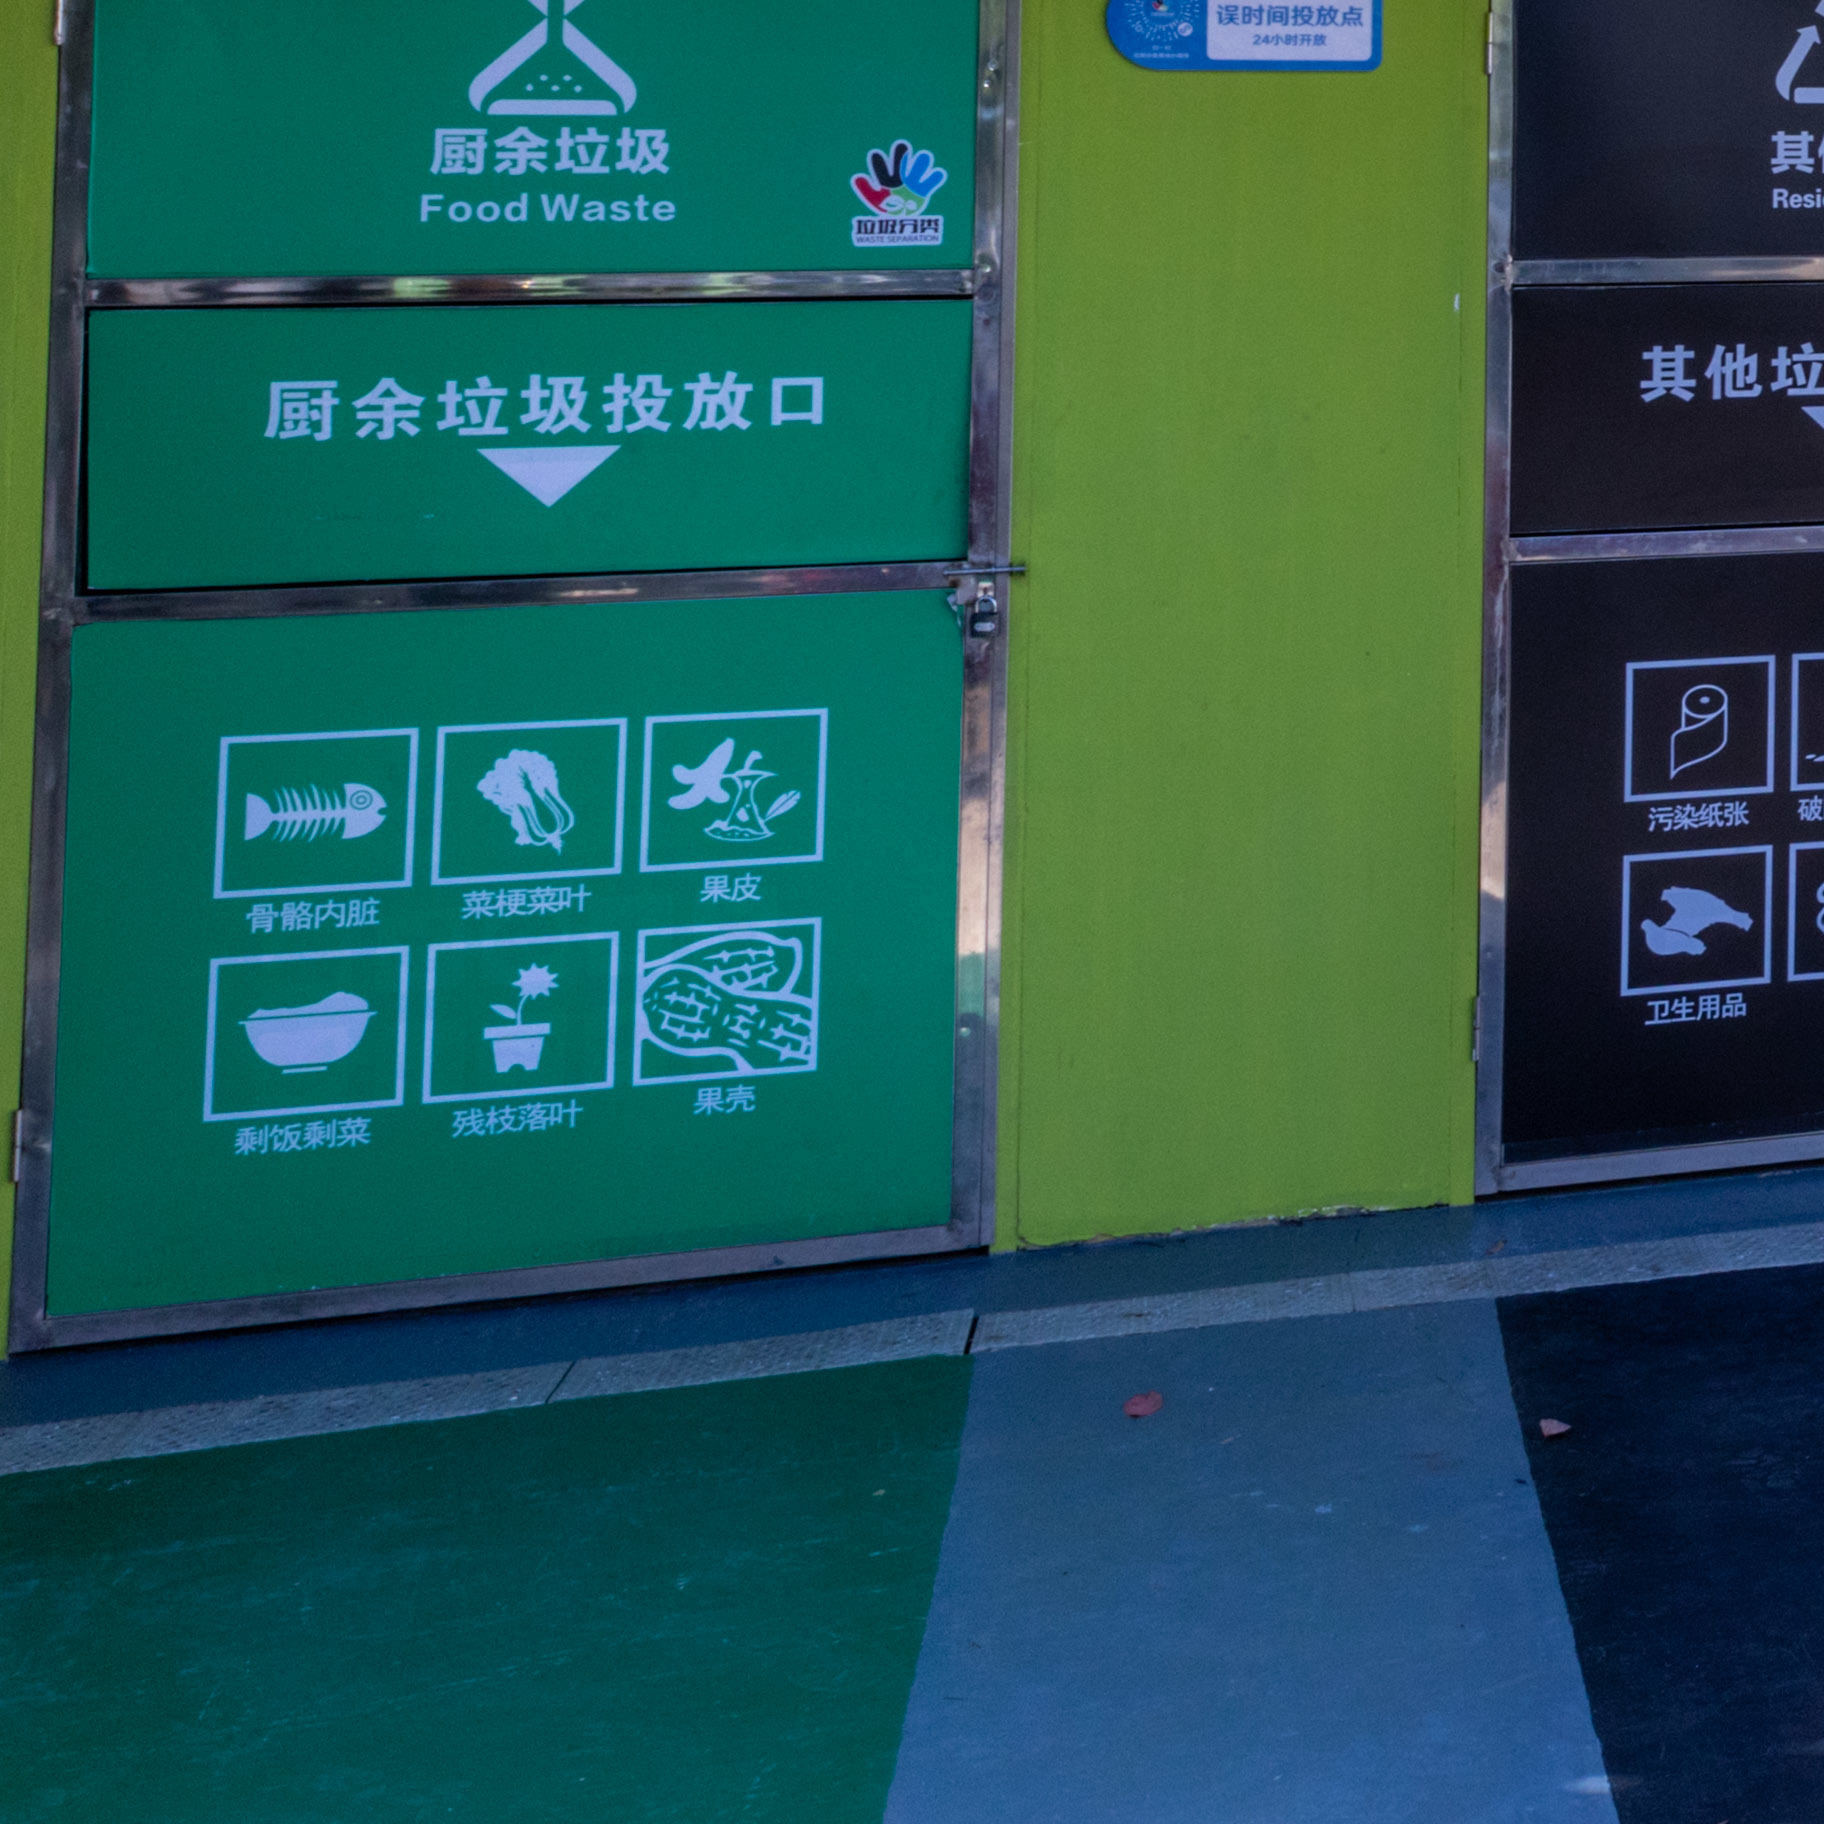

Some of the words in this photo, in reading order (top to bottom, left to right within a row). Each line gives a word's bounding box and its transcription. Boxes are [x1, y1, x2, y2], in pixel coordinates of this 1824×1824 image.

[1216, 4, 1364, 27] 误时间投放点
[1253, 34, 1327, 46] 24小时开放
[430, 127, 670, 176] 厨余垃圾
[419, 193, 530, 223] Food
[541, 191, 677, 222] Waste
[855, 219, 940, 234] 垃圾分类
[263, 371, 826, 443] 厨余垃圾投放口
[1648, 801, 1749, 832] 污染纸张
[460, 885, 591, 920] 菜梗菜叶
[699, 873, 762, 904] 果皮
[246, 896, 380, 934] 骨骼内脏
[1644, 993, 1747, 1026] 卫生用品
[693, 1084, 757, 1116] 果壳
[452, 1101, 583, 1138] 残枝落叶
[234, 1118, 371, 1156] 剩饭剩菜
